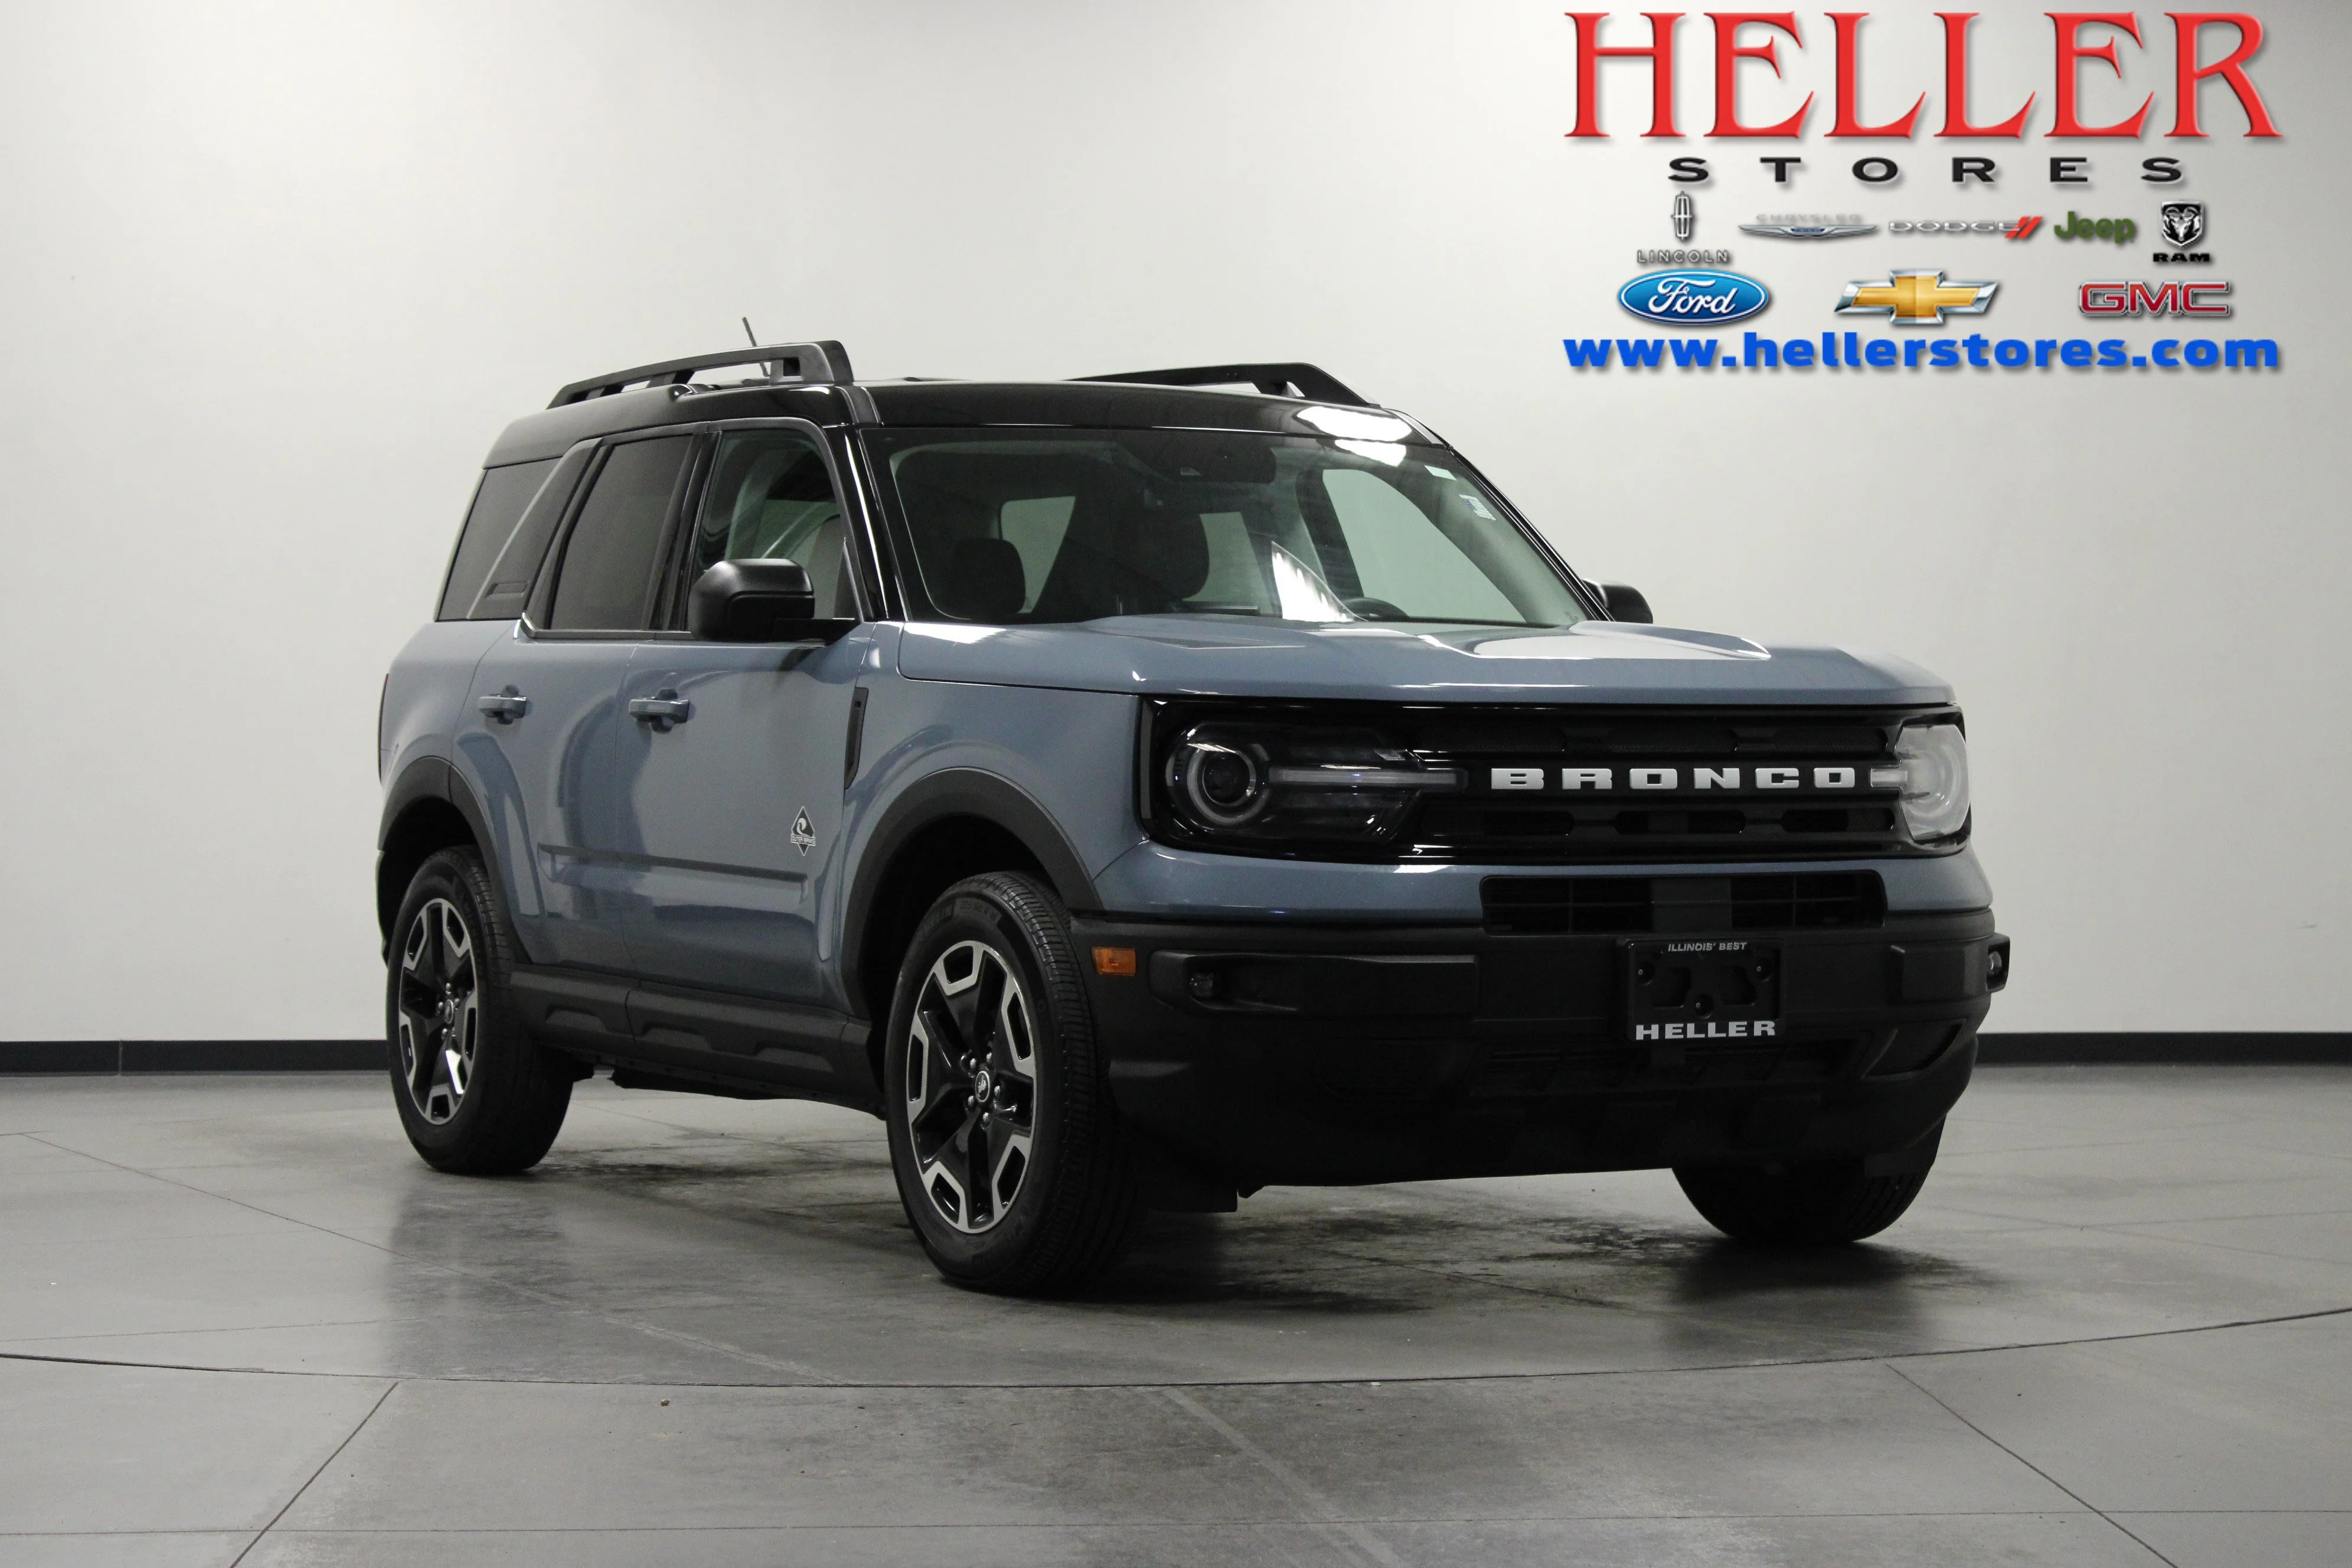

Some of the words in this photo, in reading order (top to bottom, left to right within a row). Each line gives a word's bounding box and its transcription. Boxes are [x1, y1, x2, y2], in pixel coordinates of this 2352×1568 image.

[1491, 767, 1856, 790] BRONCO
[1668, 942, 1716, 952] ILLINOIS'
[1719, 942, 1747, 951] BEST
[1635, 1020, 1776, 1040] HELLER
